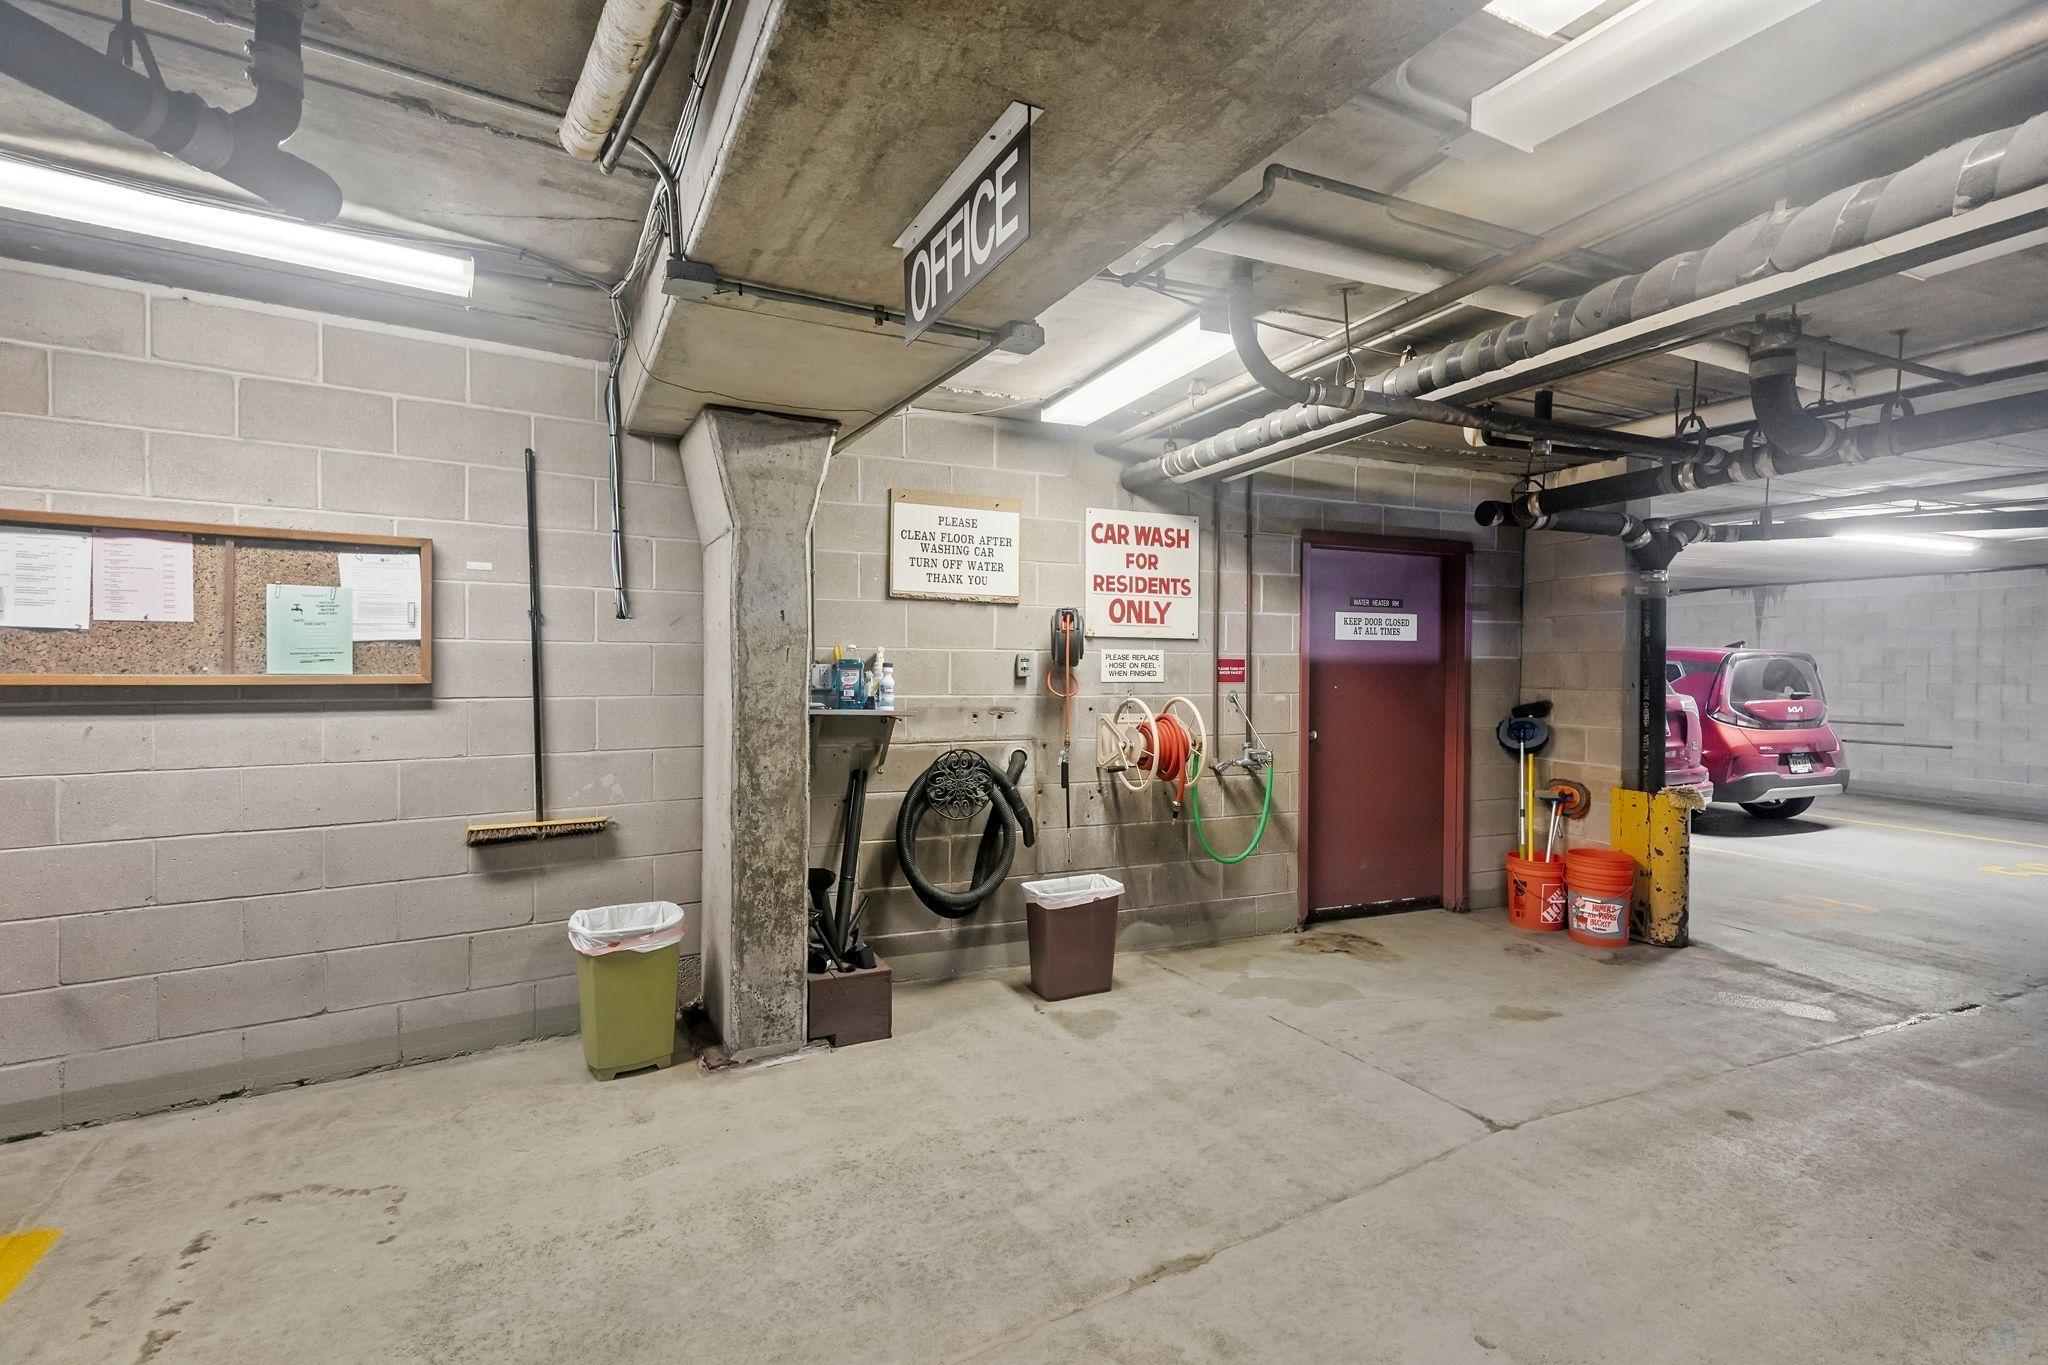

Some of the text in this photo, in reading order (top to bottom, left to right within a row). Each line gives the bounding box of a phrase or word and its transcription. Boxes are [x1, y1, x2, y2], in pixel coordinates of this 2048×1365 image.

[911, 148, 1018, 322] OFFICE
[938, 516, 978, 528] PLEASE
[900, 529, 1012, 547] CLEAN FLOOR AFTER
[1091, 523, 1190, 549] CAR WASH
[920, 543, 994, 558] WASHING CAR
[909, 556, 1004, 572] TURN OFF WATER
[1125, 552, 1159, 570] FOR
[926, 572, 988, 586] THANK YOU
[1093, 574, 1192, 596] RESIDENTS
[1372, 599, 1390, 607] HEATER
[1108, 598, 1173, 624] ONLY
[1343, 617, 1410, 627] KEEP DOOR CLOSED
[1353, 627, 1401, 636] AT ALL TIMES
[1590, 919, 1612, 928] BUCKET
